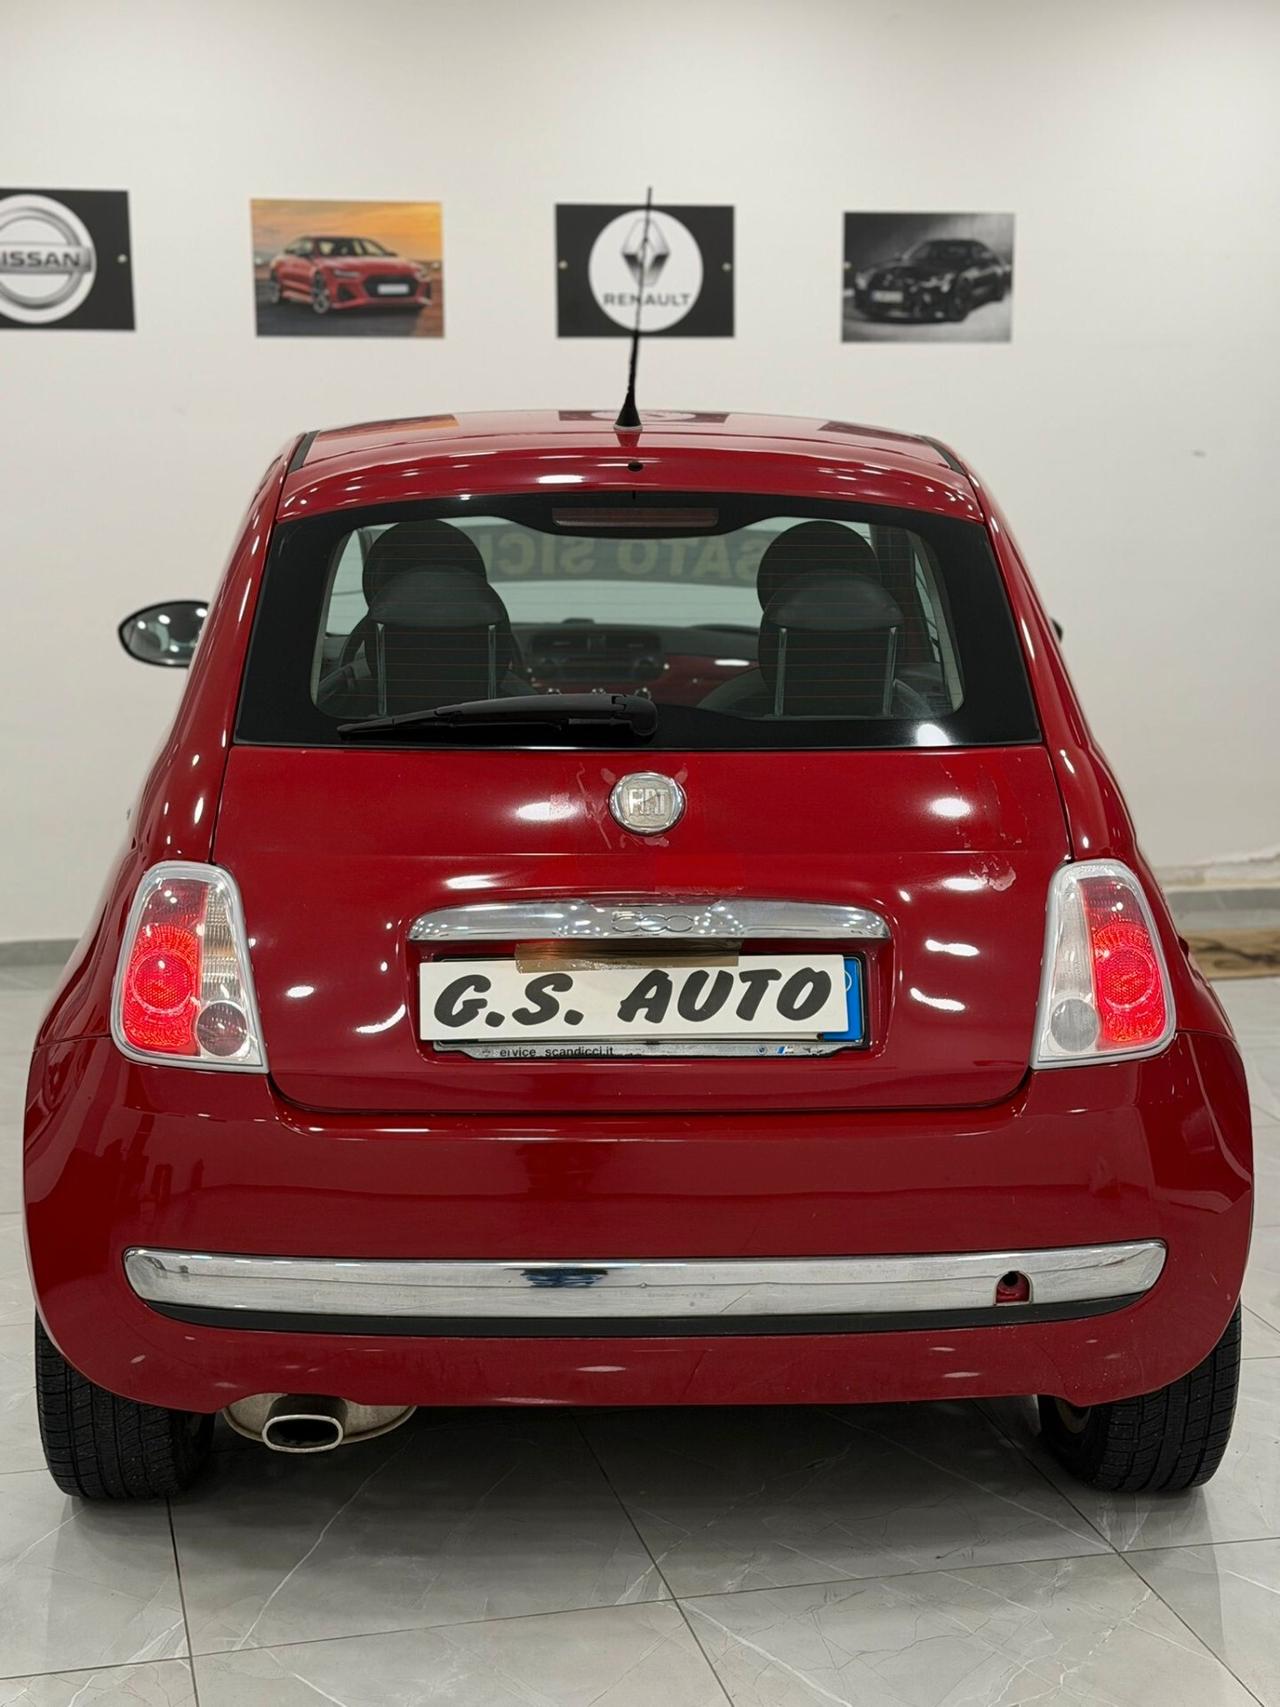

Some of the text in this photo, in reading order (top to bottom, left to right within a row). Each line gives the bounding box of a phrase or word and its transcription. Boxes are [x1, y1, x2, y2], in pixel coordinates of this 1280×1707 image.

[0, 251, 80, 268] ISSAN
[603, 293, 691, 307] RENAULT
[611, 911, 694, 932] 500
[434, 967, 832, 1028] G.S. AUTO
